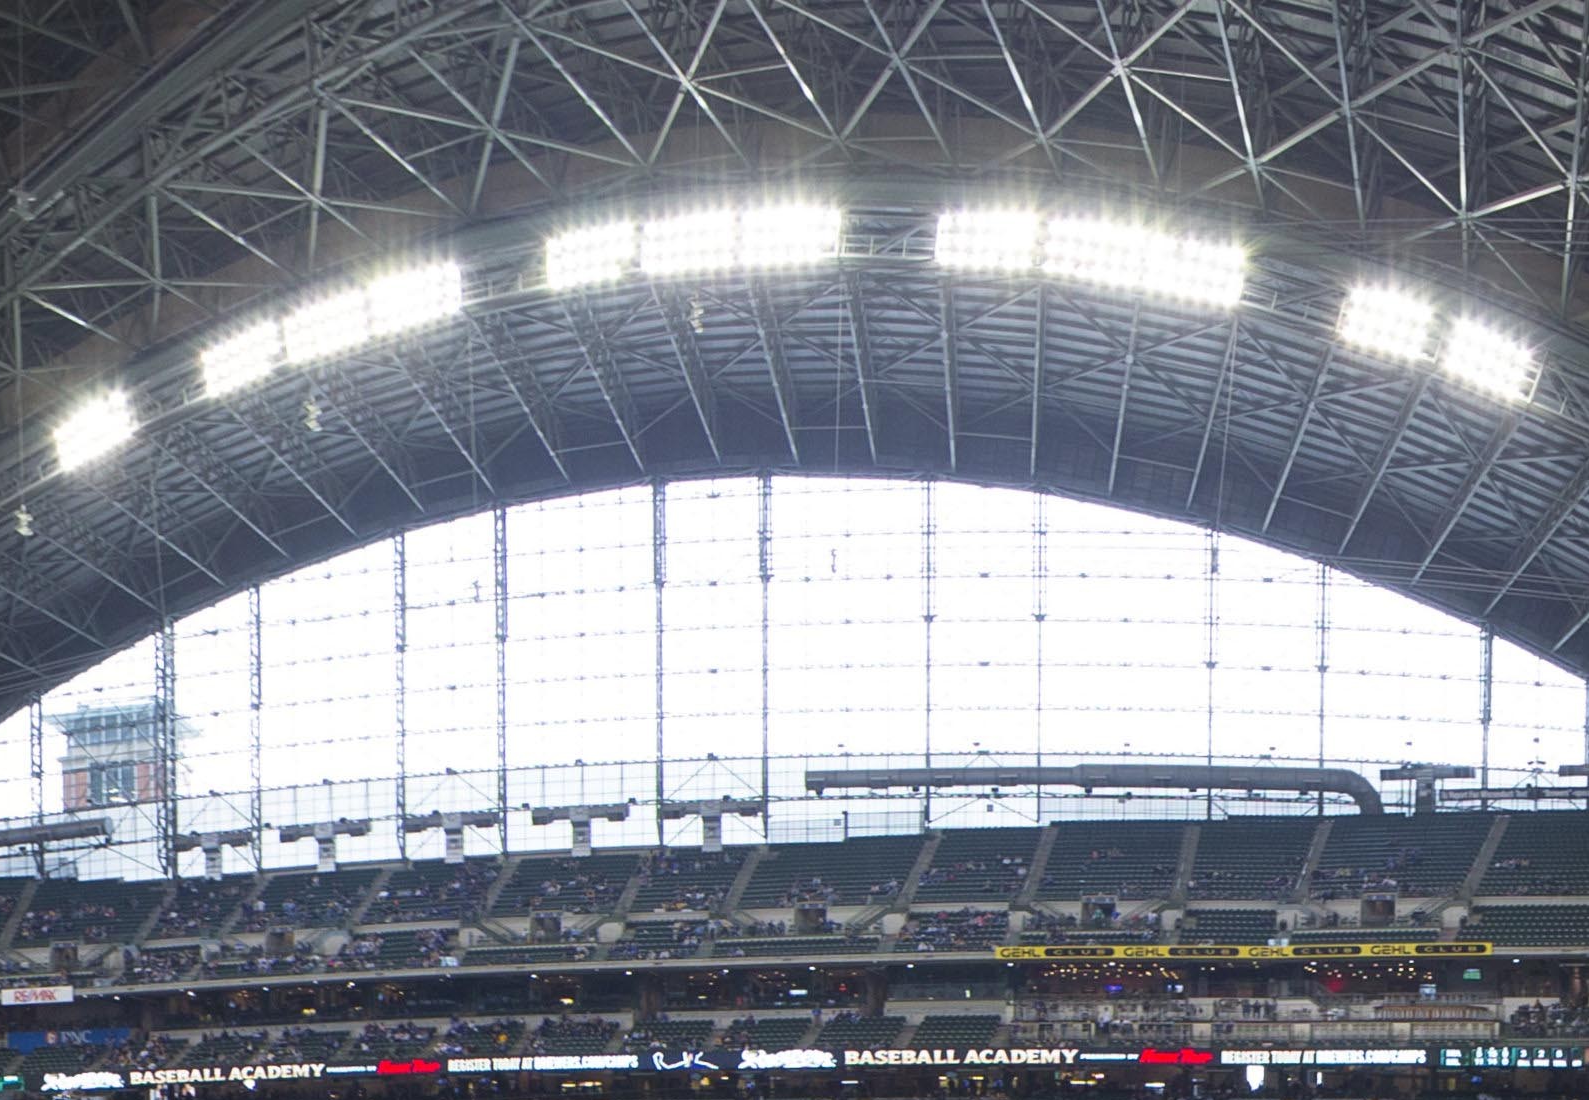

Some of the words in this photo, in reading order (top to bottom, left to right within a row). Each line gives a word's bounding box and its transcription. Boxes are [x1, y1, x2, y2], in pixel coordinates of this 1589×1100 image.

[844, 1049, 960, 1065] BASEBALL
[963, 1049, 1079, 1065] ACADEMY
[130, 1066, 225, 1085] BASEBALL
[229, 1063, 325, 1081] ACADEMY
